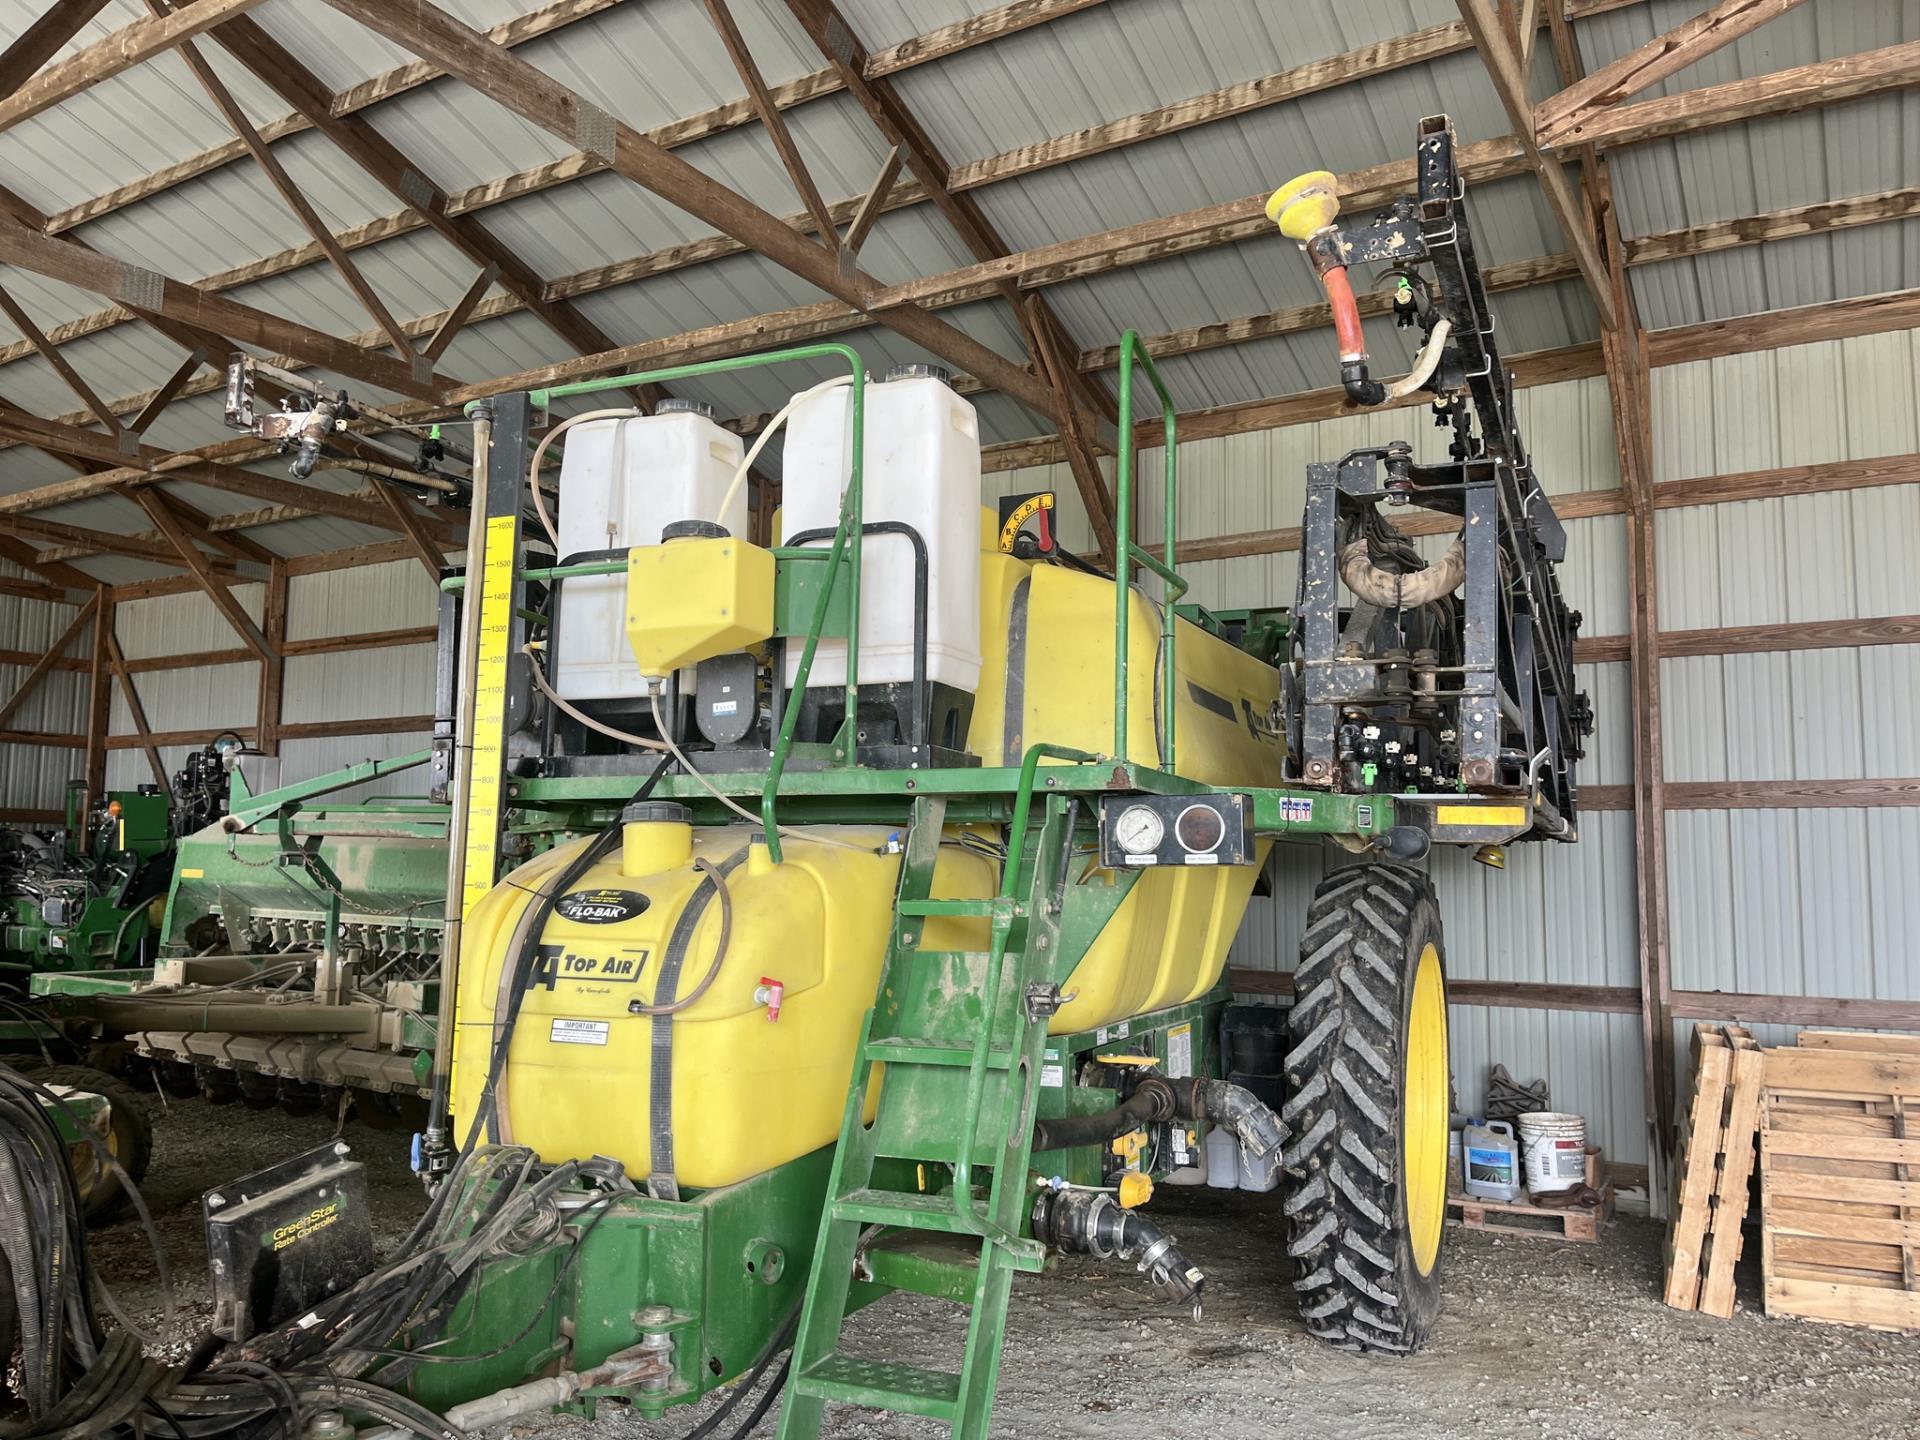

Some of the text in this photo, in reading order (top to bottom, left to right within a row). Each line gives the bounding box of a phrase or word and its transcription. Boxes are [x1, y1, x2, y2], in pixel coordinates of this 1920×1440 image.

[1006, 528, 1011, 536] B
[1014, 513, 1020, 521] C
[1026, 503, 1032, 511] D
[498, 522, 513, 530] 1600
[496, 560, 511, 568] 1500
[494, 593, 509, 601] 1400
[492, 624, 507, 633] 1300
[490, 656, 505, 664] 1200
[488, 686, 503, 694] 1100
[486, 715, 501, 724] 1000
[483, 745, 496, 753] 900
[482, 776, 494, 784] 800
[480, 808, 492, 817] 700
[475, 881, 487, 890] 500
[568, 906, 623, 918] FLO-BAK
[564, 1021, 597, 1029] IMPORTANT
[273, 1203, 337, 1240] GreenStar
[274, 1213, 339, 1251] Rate Controller
